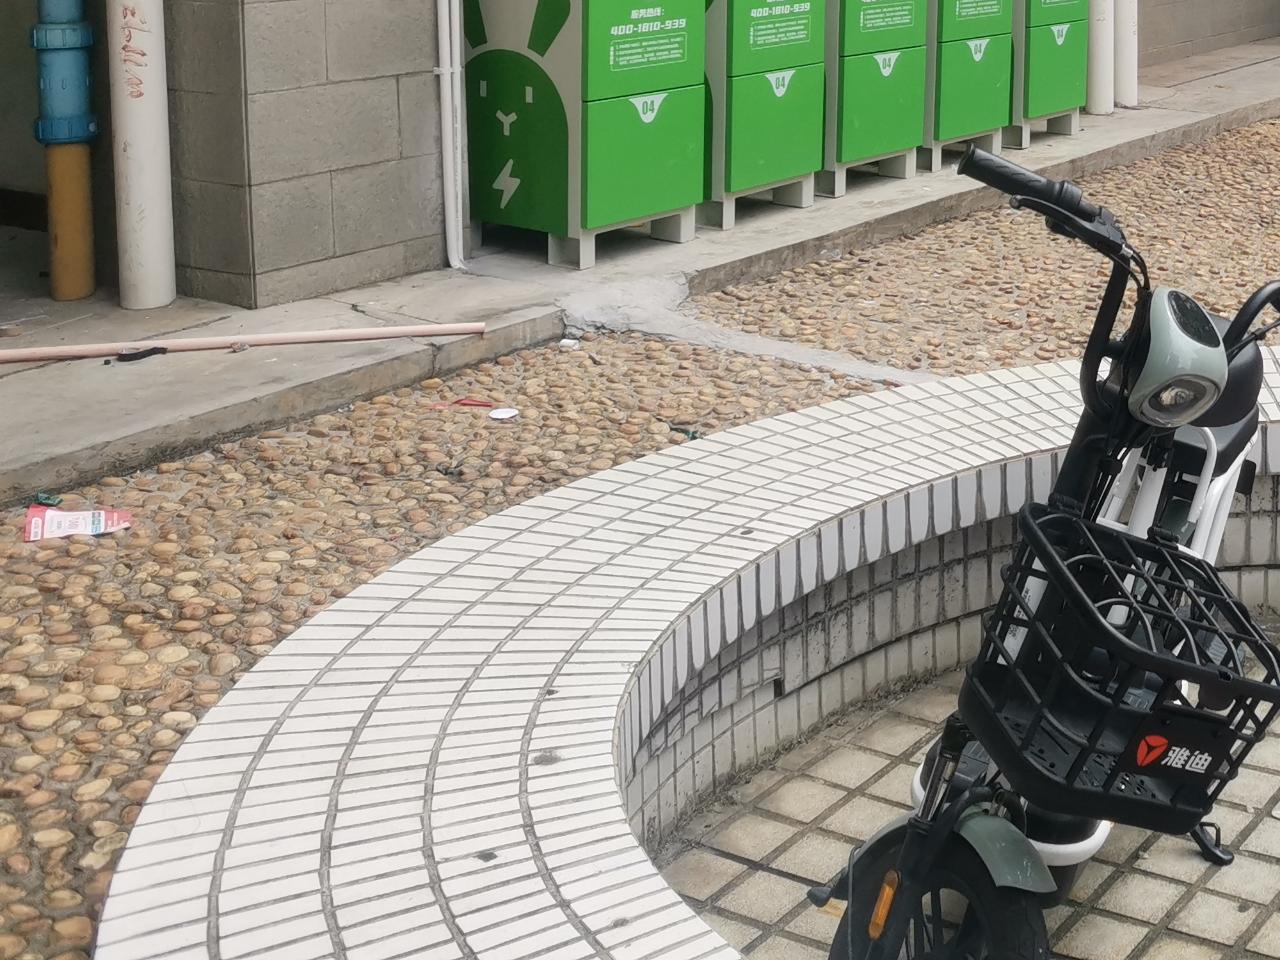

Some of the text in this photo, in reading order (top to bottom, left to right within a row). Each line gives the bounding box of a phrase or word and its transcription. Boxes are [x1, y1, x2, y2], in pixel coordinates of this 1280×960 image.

[751, 2, 811, 17] 400-1810-939
[610, 18, 686, 36] 400-1810-939
[882, 57, 891, 70] 04
[775, 76, 786, 90] 04
[642, 100, 655, 115] 04
[1161, 746, 1212, 773] 雅迪
